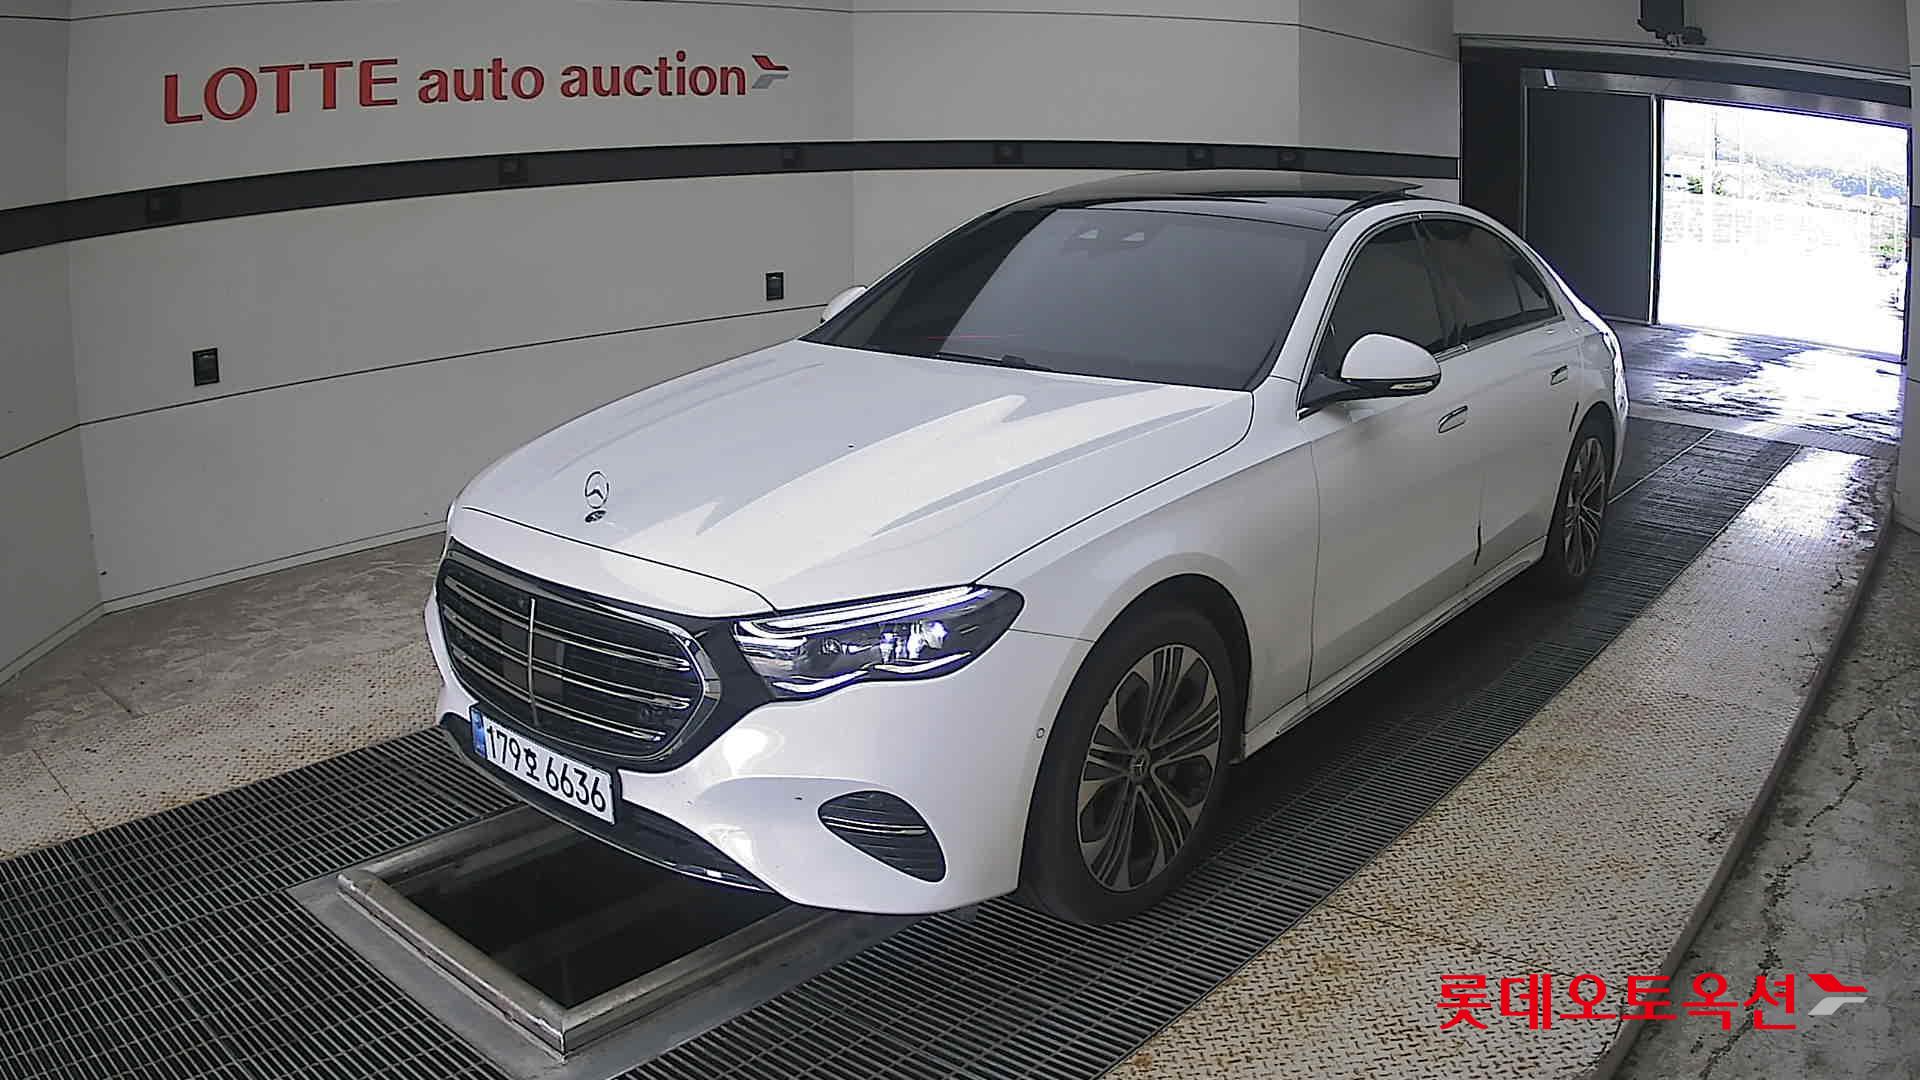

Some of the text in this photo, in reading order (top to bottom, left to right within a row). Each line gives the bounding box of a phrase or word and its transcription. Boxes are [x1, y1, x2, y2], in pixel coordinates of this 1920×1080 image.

[163, 51, 748, 125] LOTTE auto auction
[486, 725, 606, 813] 179호 6636
